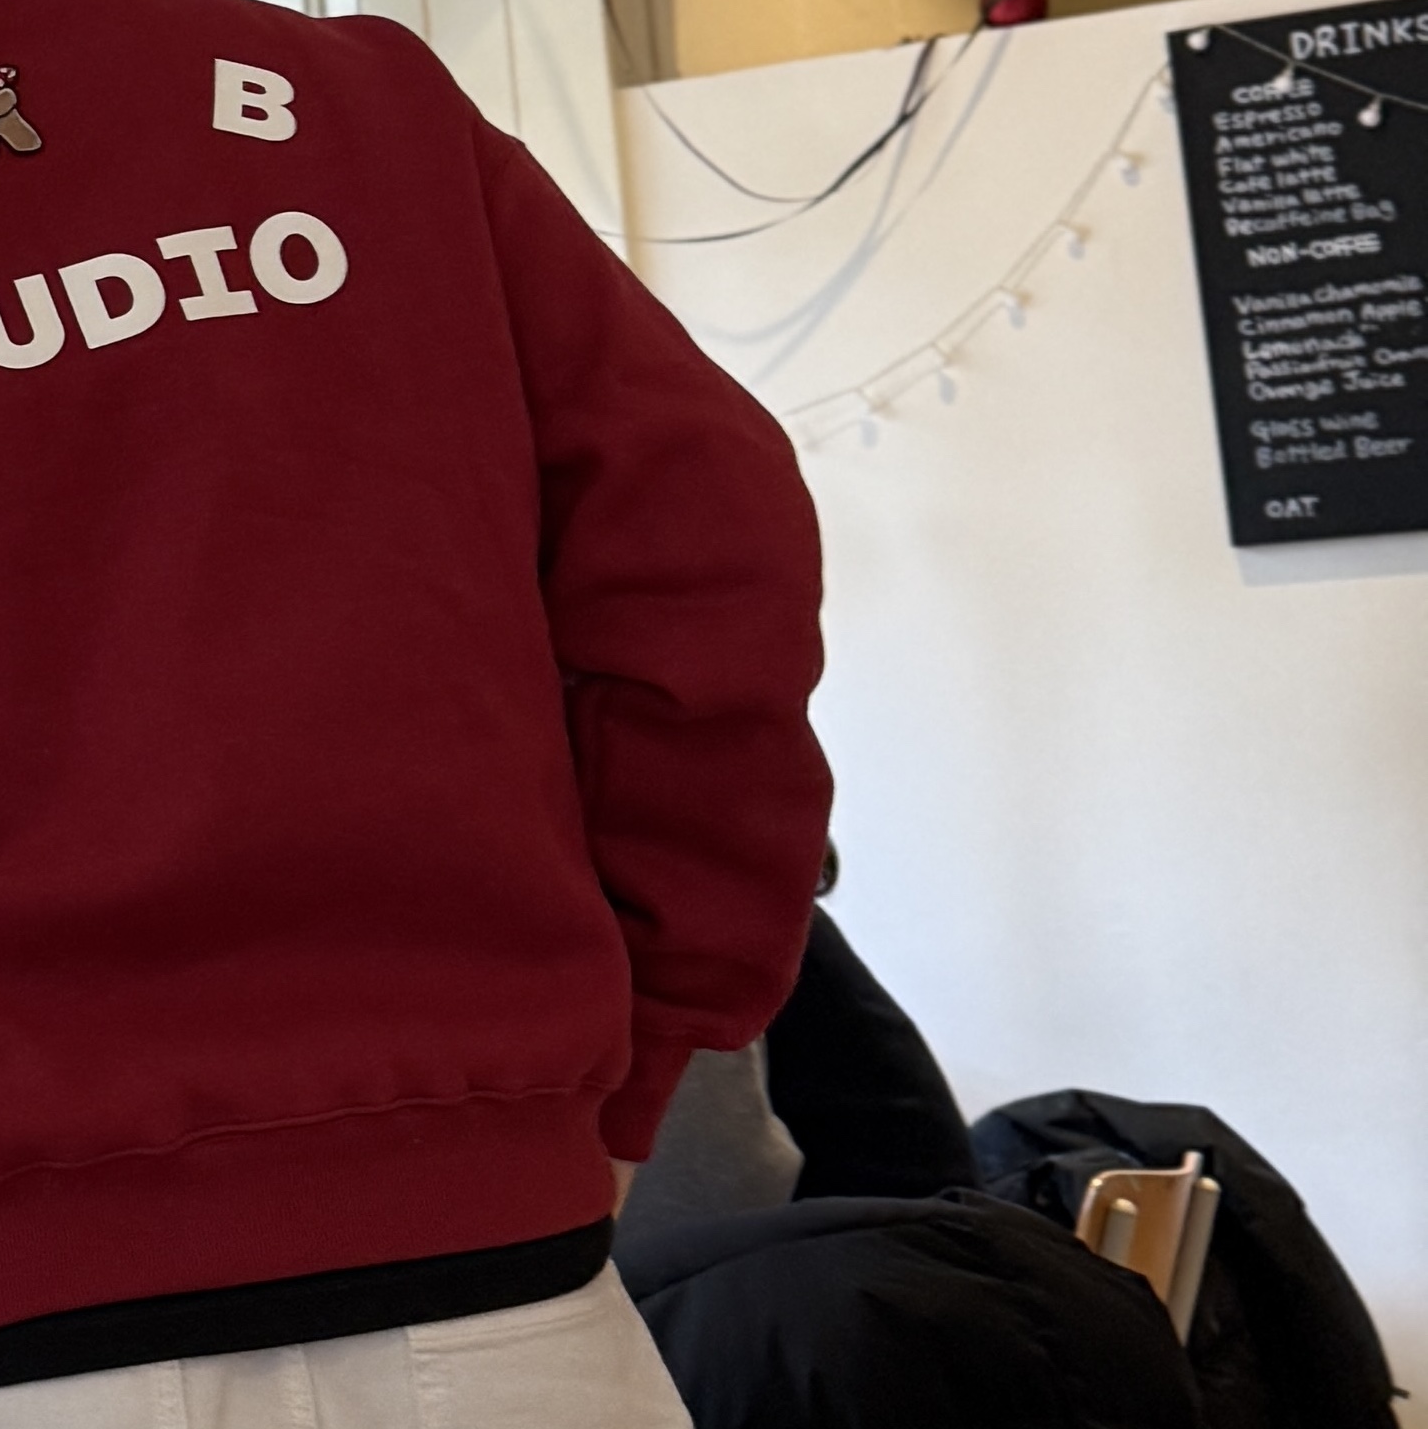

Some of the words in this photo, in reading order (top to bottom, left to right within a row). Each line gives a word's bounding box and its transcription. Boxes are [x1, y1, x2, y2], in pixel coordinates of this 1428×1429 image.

[1290, 16, 1428, 60] DRINKS
[212, 58, 298, 142] B
[1232, 78, 1313, 102] COFEE
[1213, 103, 1320, 130] Espresso
[1216, 123, 1342, 153] Americano
[1266, 496, 1318, 517] OAT
